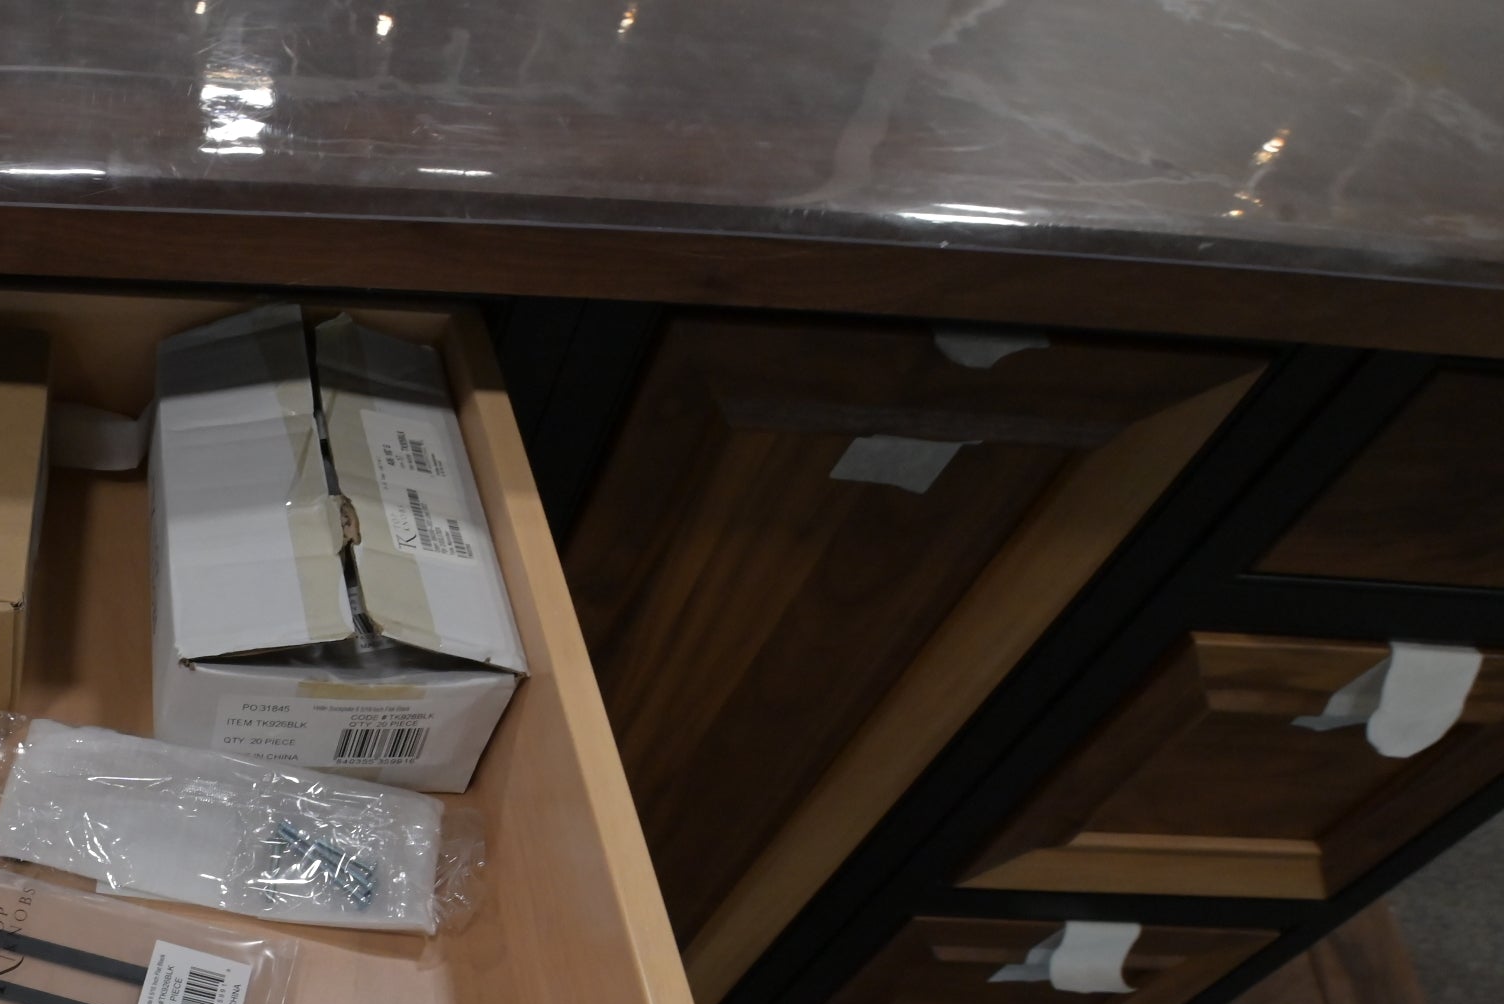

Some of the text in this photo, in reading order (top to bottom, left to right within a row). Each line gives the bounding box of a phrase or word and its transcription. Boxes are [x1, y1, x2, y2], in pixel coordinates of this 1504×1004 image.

[226, 718, 253, 727] ITEM
[390, 720, 418, 728] PIECE
[264, 738, 296, 746] PIECE
[266, 753, 299, 761] CHINA
[3, 887, 36, 950] KNOBS
[170, 977, 183, 1002] PIECE
